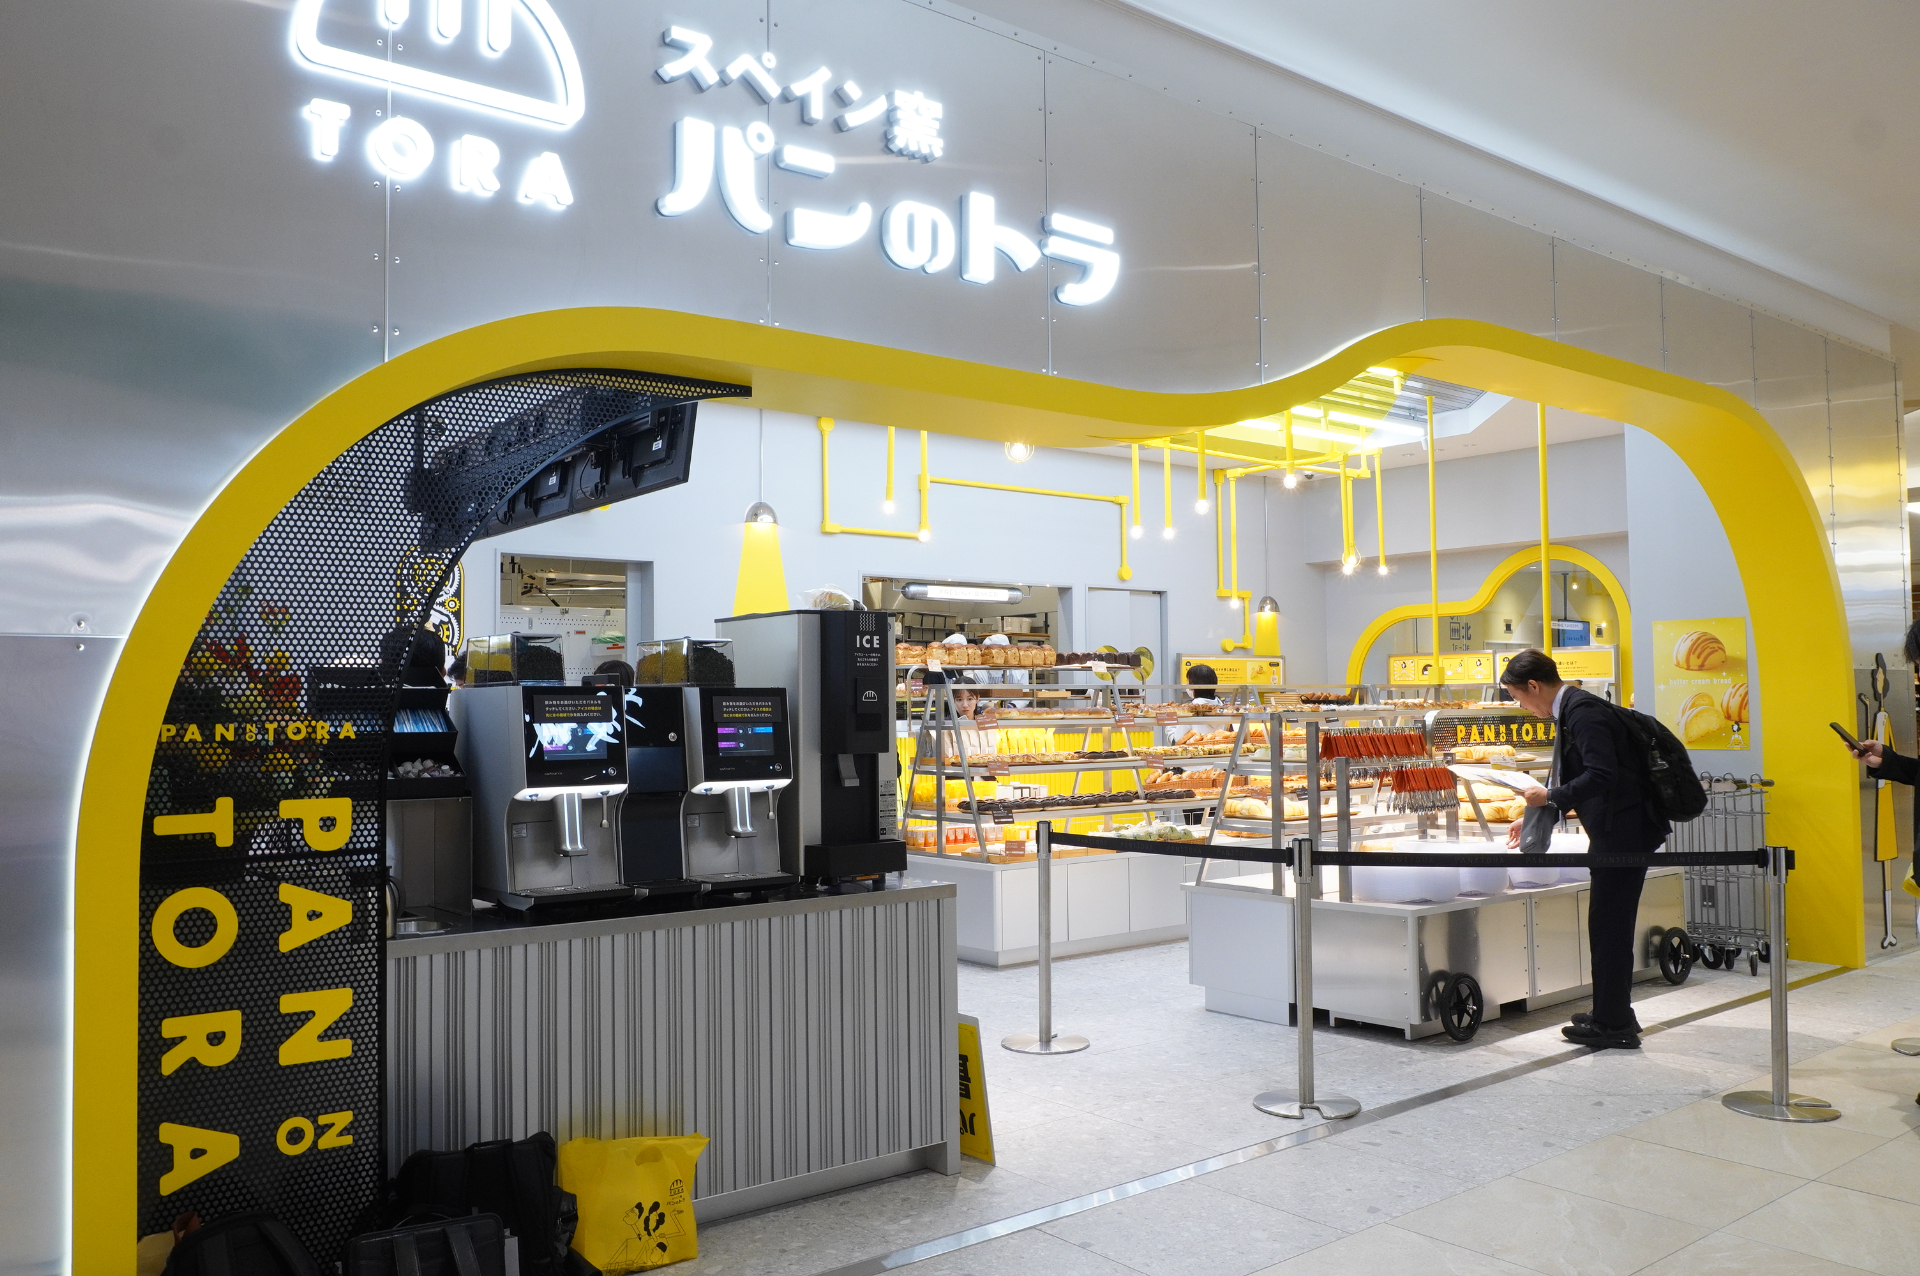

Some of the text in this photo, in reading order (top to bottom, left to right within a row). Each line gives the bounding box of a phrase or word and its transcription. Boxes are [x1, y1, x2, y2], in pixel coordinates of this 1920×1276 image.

[304, 97, 575, 211] TORA
[655, 24, 945, 163] スペイン窯
[656, 115, 1121, 308] パンのトラ
[856, 635, 880, 648] ICE
[151, 796, 243, 1197] TORA
